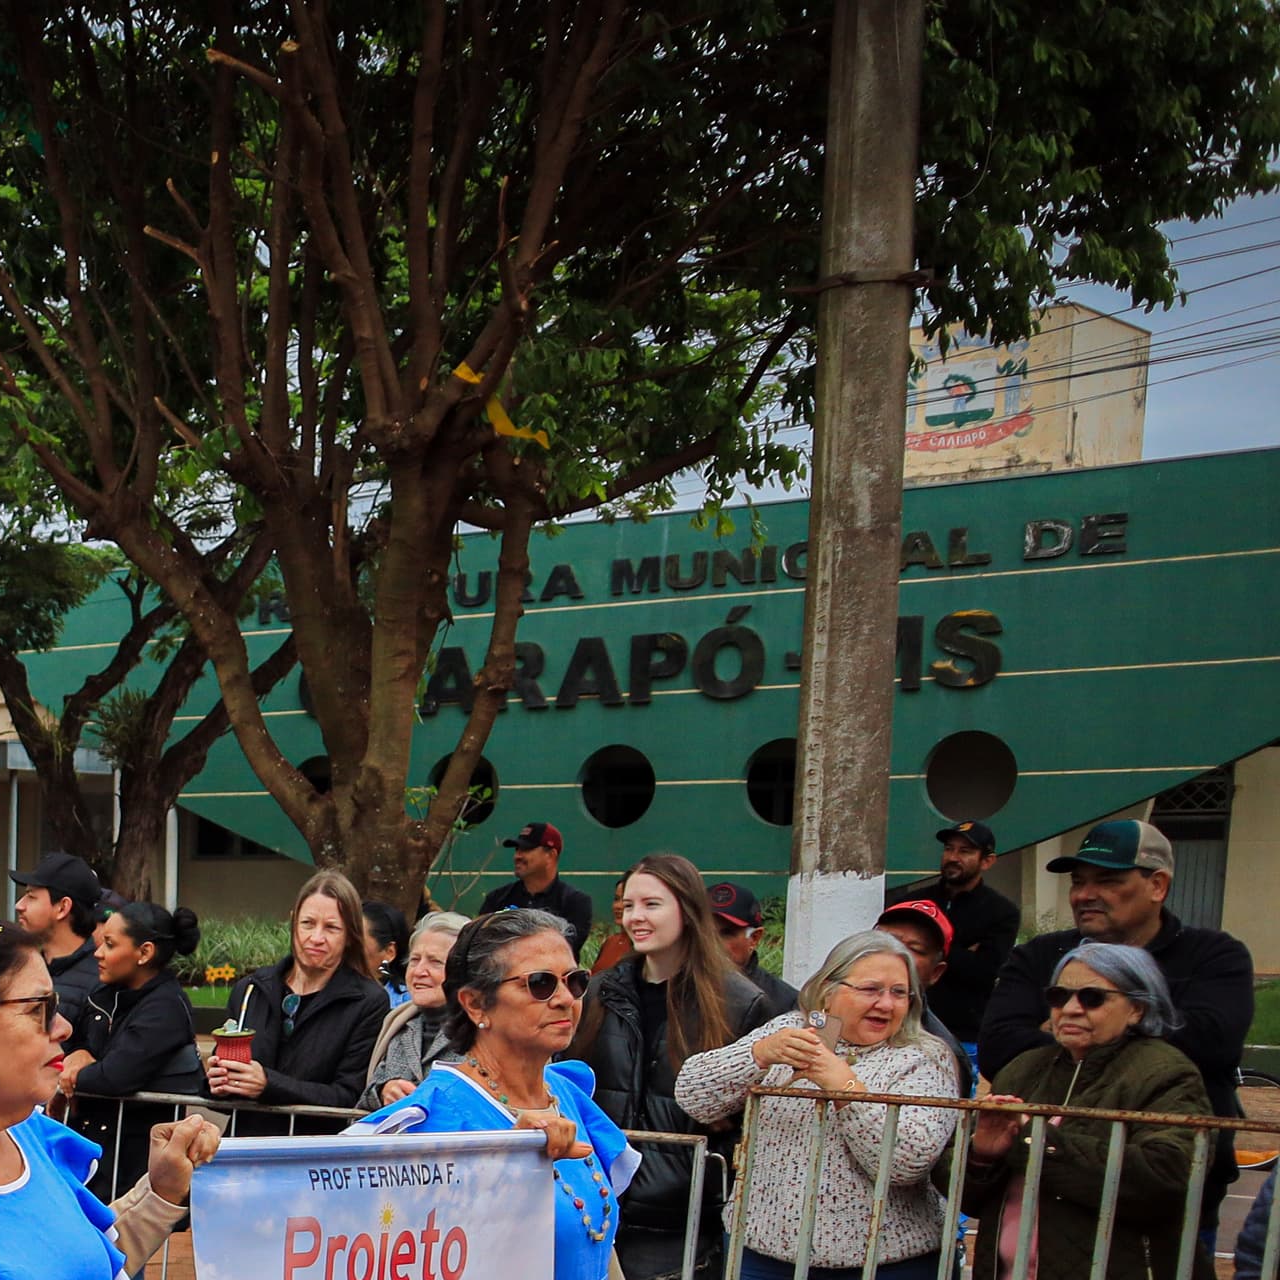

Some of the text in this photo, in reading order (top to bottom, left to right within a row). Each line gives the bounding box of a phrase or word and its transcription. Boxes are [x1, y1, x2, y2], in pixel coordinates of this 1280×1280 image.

[610, 527, 992, 596] MUNICAL
[1023, 512, 1130, 560] DE
[308, 1162, 461, 1191] PROF FERNANDA F.
